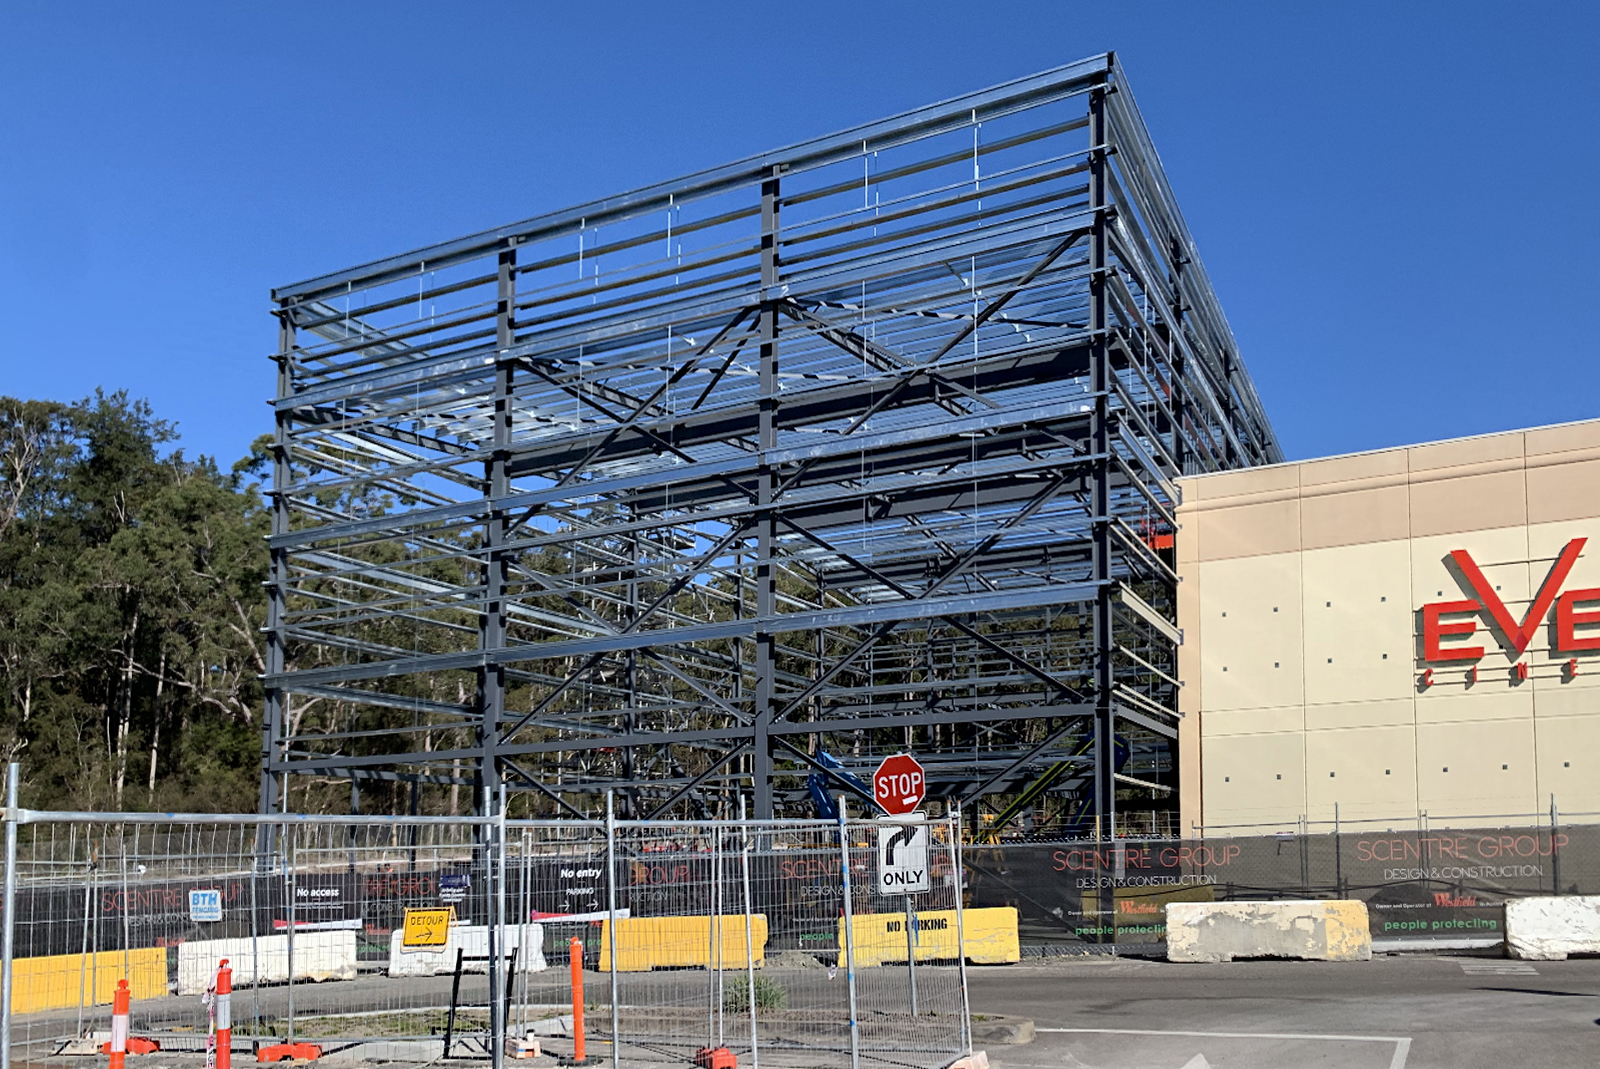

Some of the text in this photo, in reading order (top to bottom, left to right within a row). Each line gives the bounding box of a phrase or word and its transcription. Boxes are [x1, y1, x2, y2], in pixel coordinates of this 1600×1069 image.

[878, 772, 921, 799] STOP
[1357, 834, 1569, 861] SCENTRE GROUP
[1053, 845, 1241, 871] SCENTRE GROUP
[560, 868, 602, 879] No entry
[883, 869, 923, 885] ONLY
[297, 888, 340, 897] No access
[1120, 900, 1158, 914] Westfield
[1433, 892, 1477, 908] Westfield
[410, 915, 444, 926] DETOUR
[887, 918, 948, 932] NO RKING
[1384, 918, 1497, 931] people protecting
[1075, 925, 1114, 936] people
